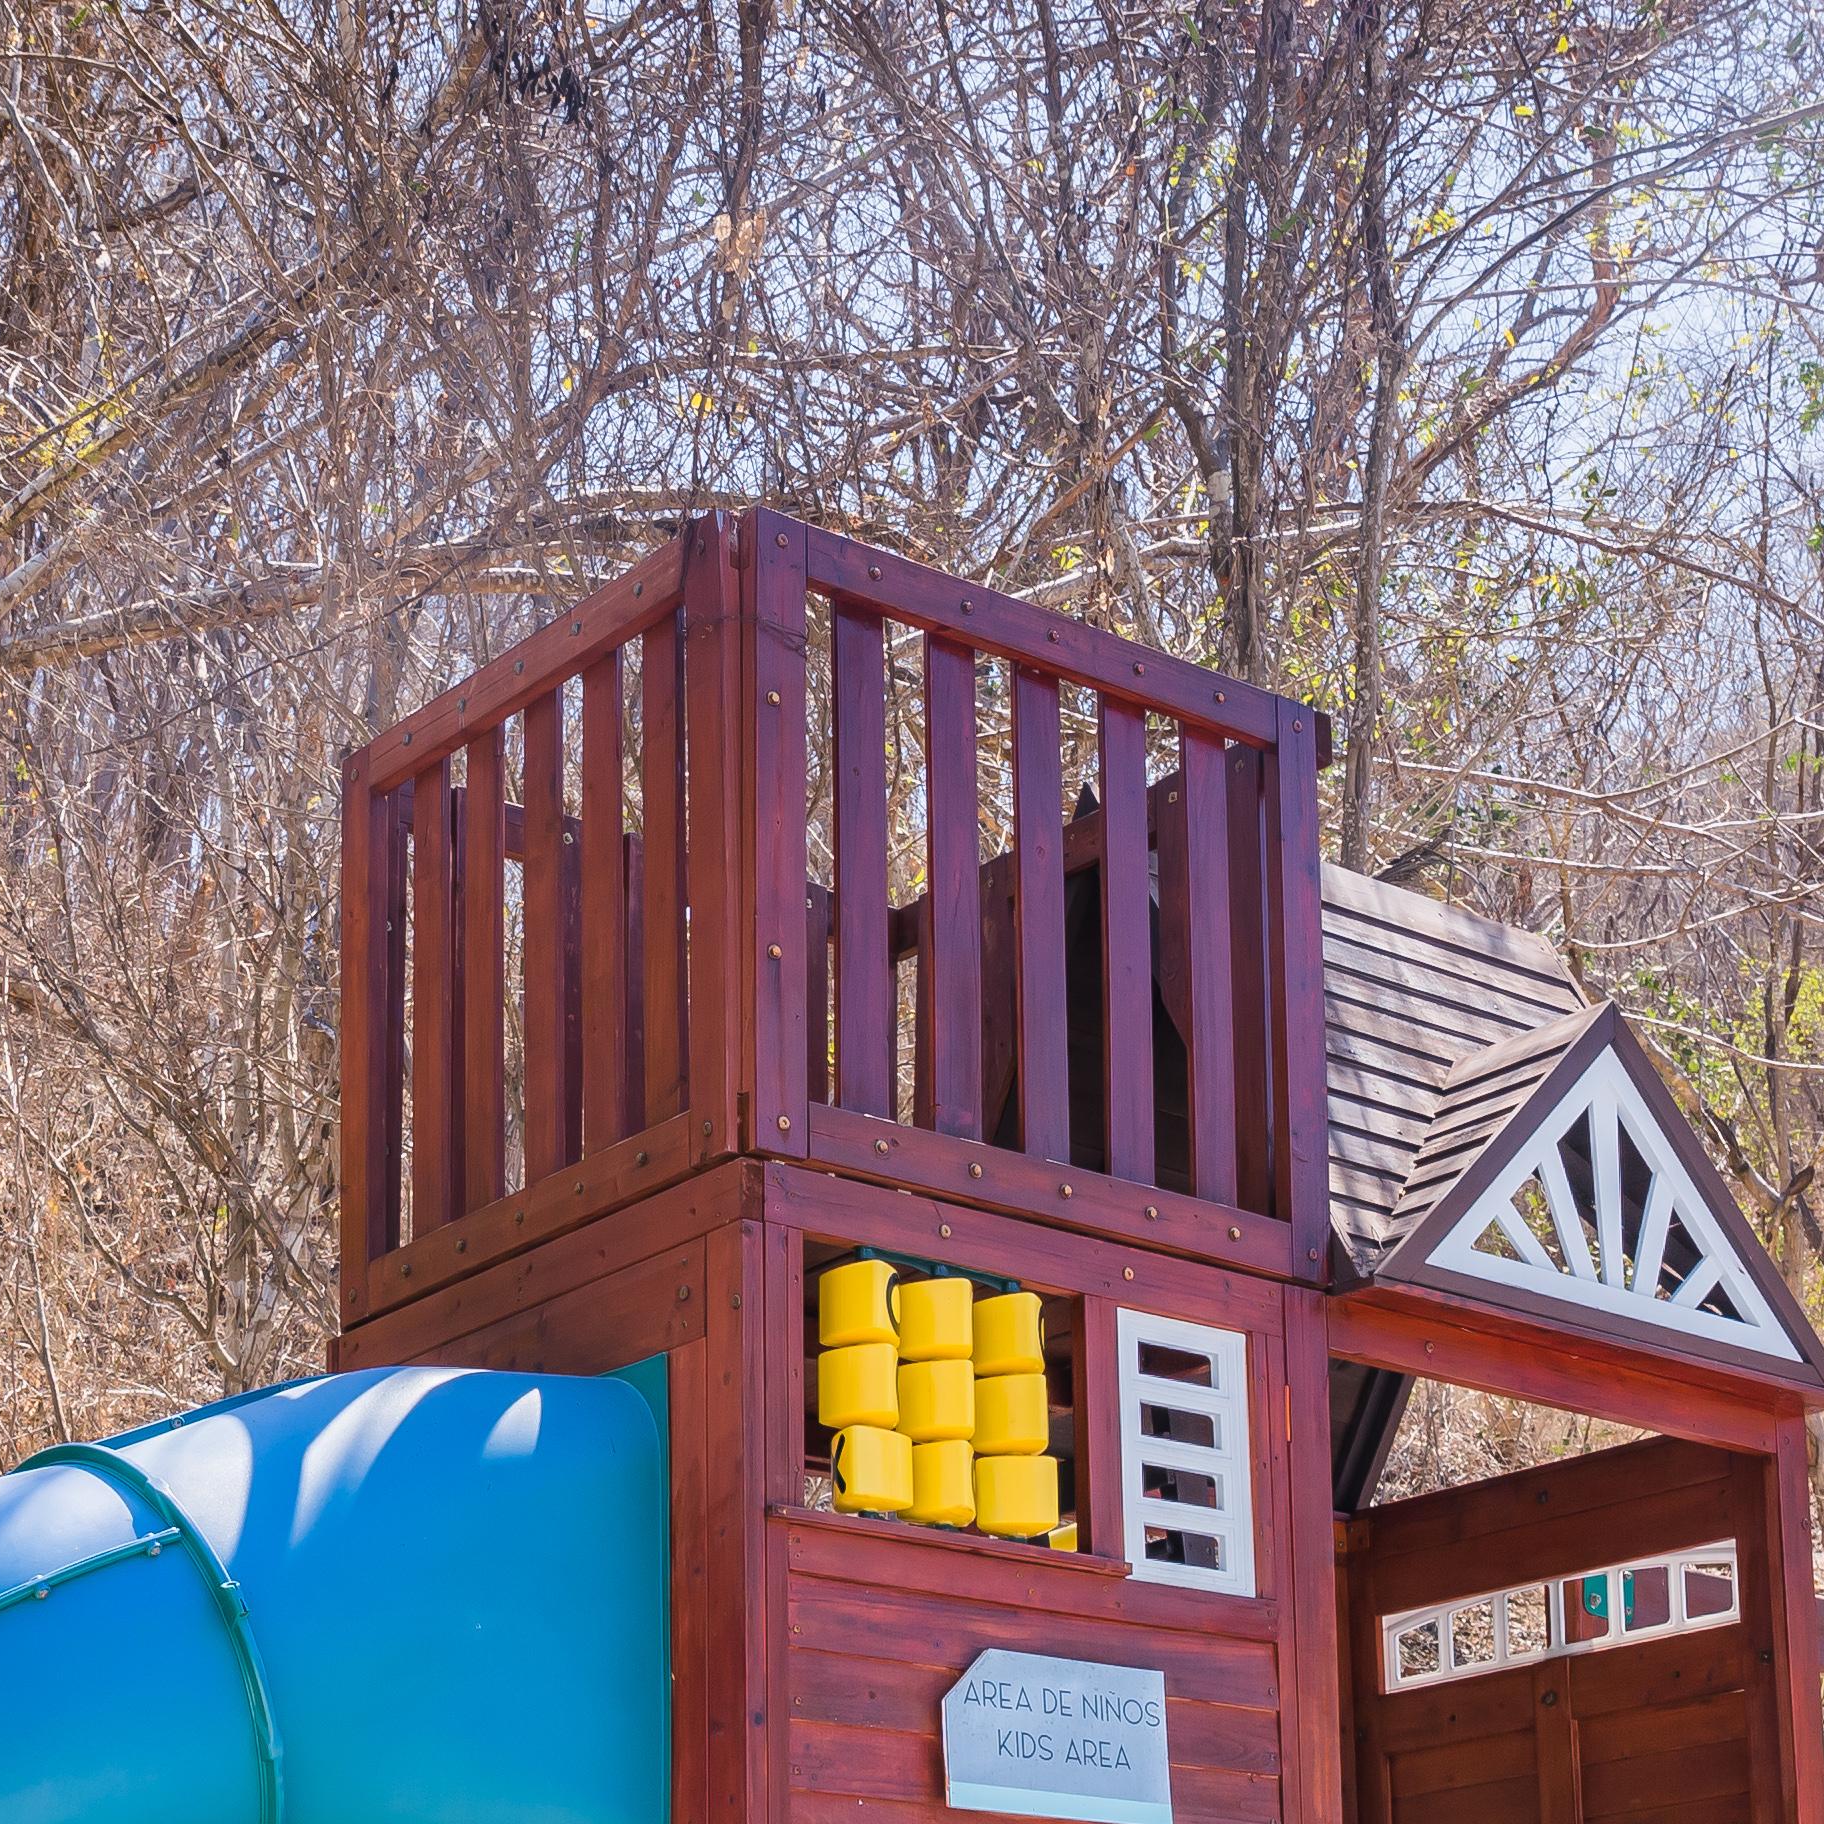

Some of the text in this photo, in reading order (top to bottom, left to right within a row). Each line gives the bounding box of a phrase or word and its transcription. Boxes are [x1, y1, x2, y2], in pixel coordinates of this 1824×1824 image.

[964, 1679, 1161, 1728] AREA DE NIÑOS
[997, 1728, 1132, 1771] KIDS AREA
